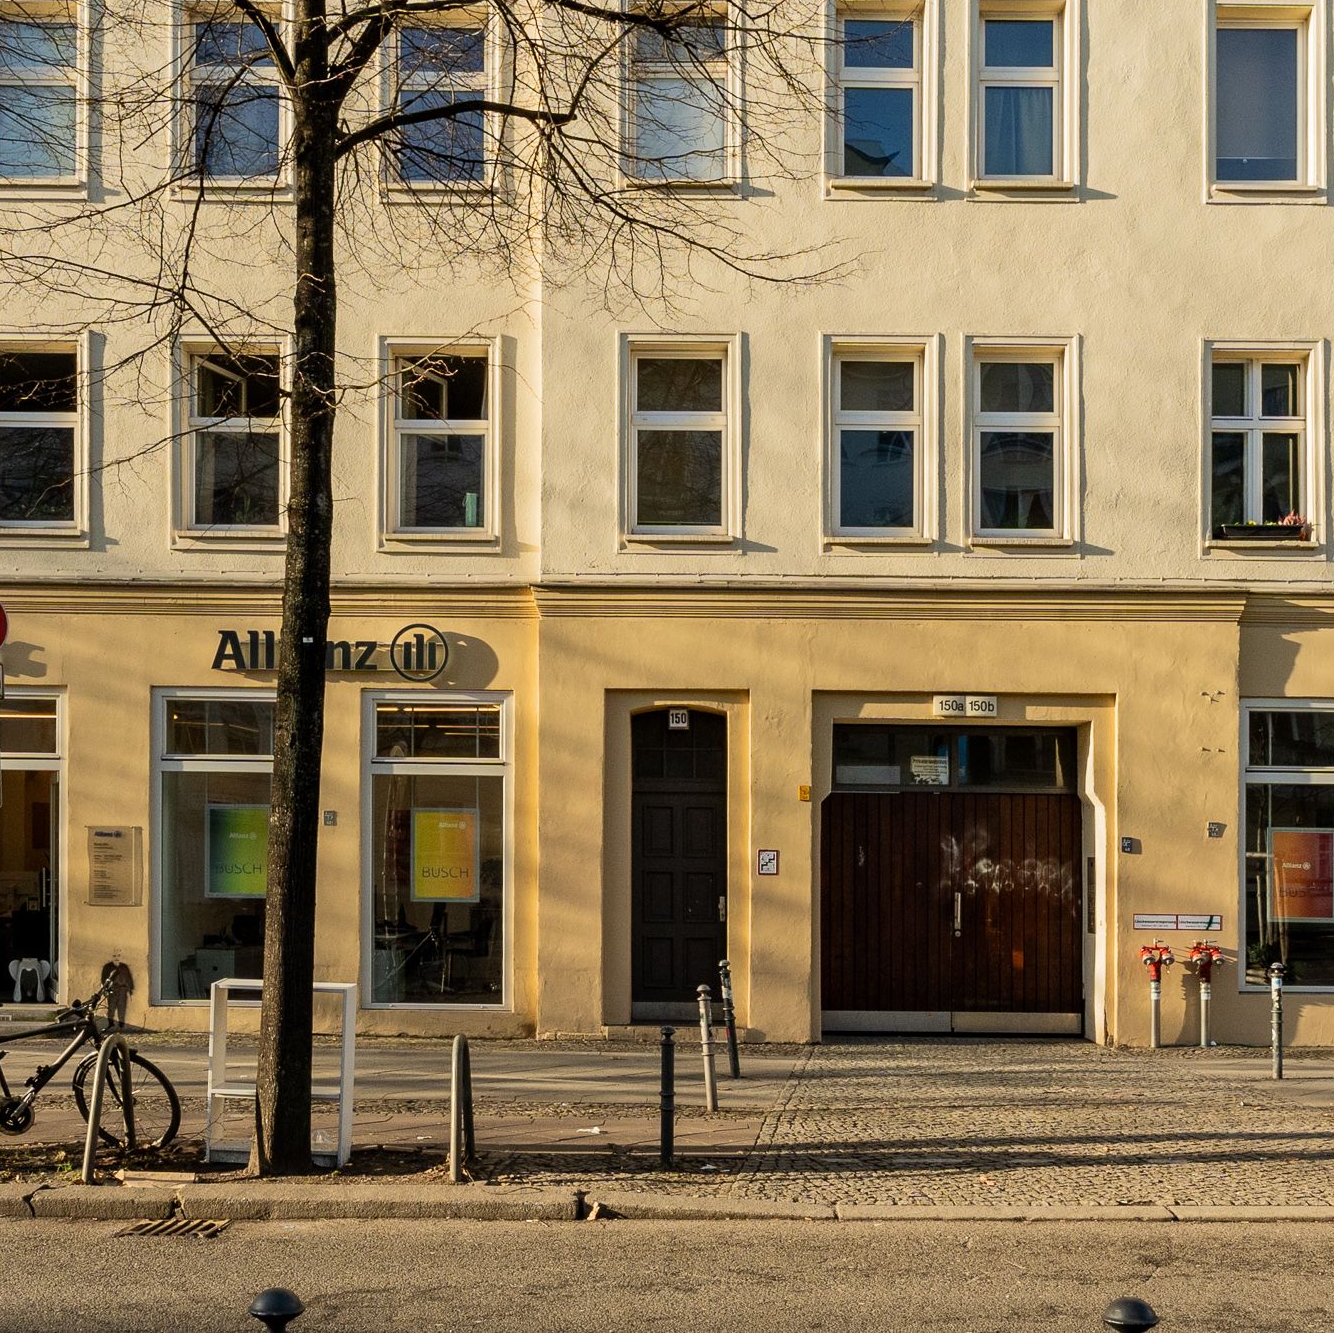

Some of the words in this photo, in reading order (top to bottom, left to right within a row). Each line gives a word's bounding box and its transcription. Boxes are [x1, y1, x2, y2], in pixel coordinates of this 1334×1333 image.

[211, 630, 377, 669] Allnz
[939, 700, 964, 712] 150a
[968, 700, 995, 712] 150b
[670, 712, 687, 724] 150
